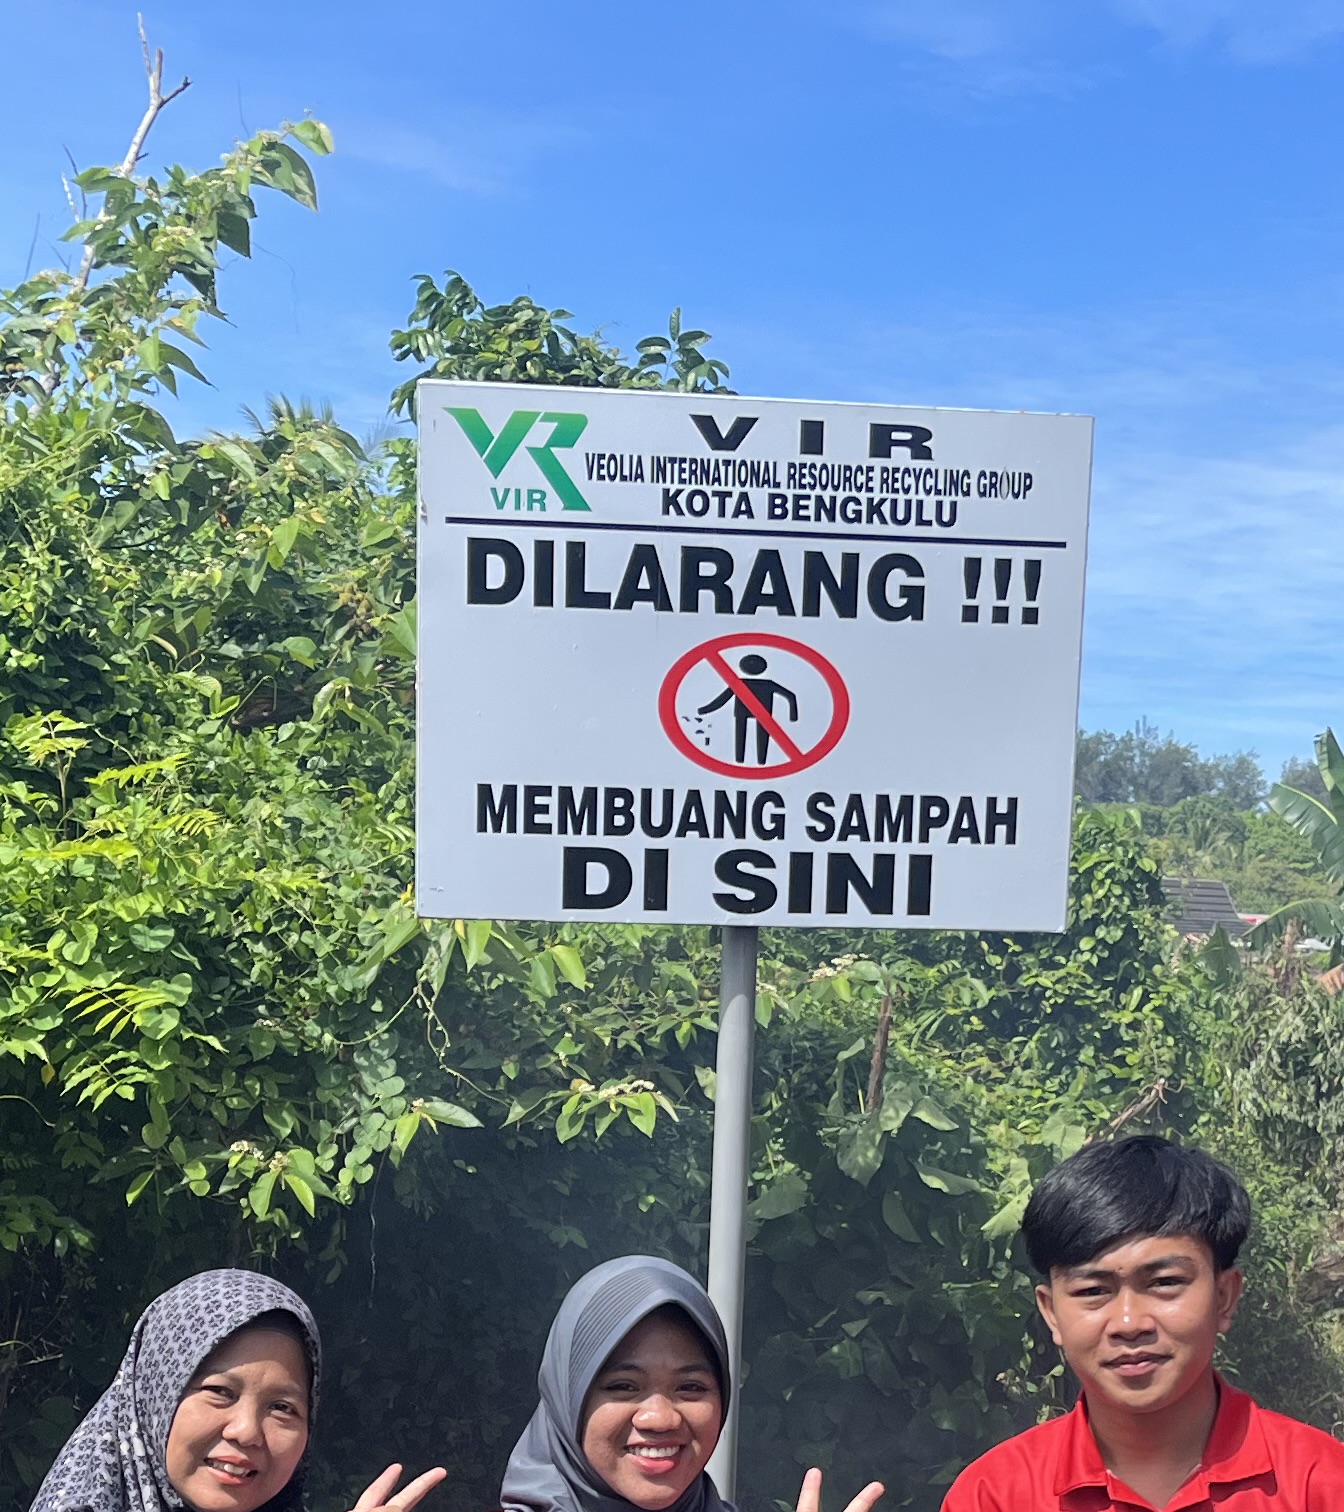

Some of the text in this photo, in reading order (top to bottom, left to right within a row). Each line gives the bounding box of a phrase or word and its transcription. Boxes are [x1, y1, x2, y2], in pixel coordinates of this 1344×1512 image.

[490, 487, 548, 512] VIR
[584, 452, 1034, 501] VEOLIA INTERNATIONAL RESOURCE RECYCLING GROUP
[661, 487, 958, 529] KOTA BENGKULU
[465, 536, 1043, 625] DILARANG !!!
[476, 783, 1019, 846] MEMBUANG SAMPAH
[562, 846, 934, 917] DI SINI
